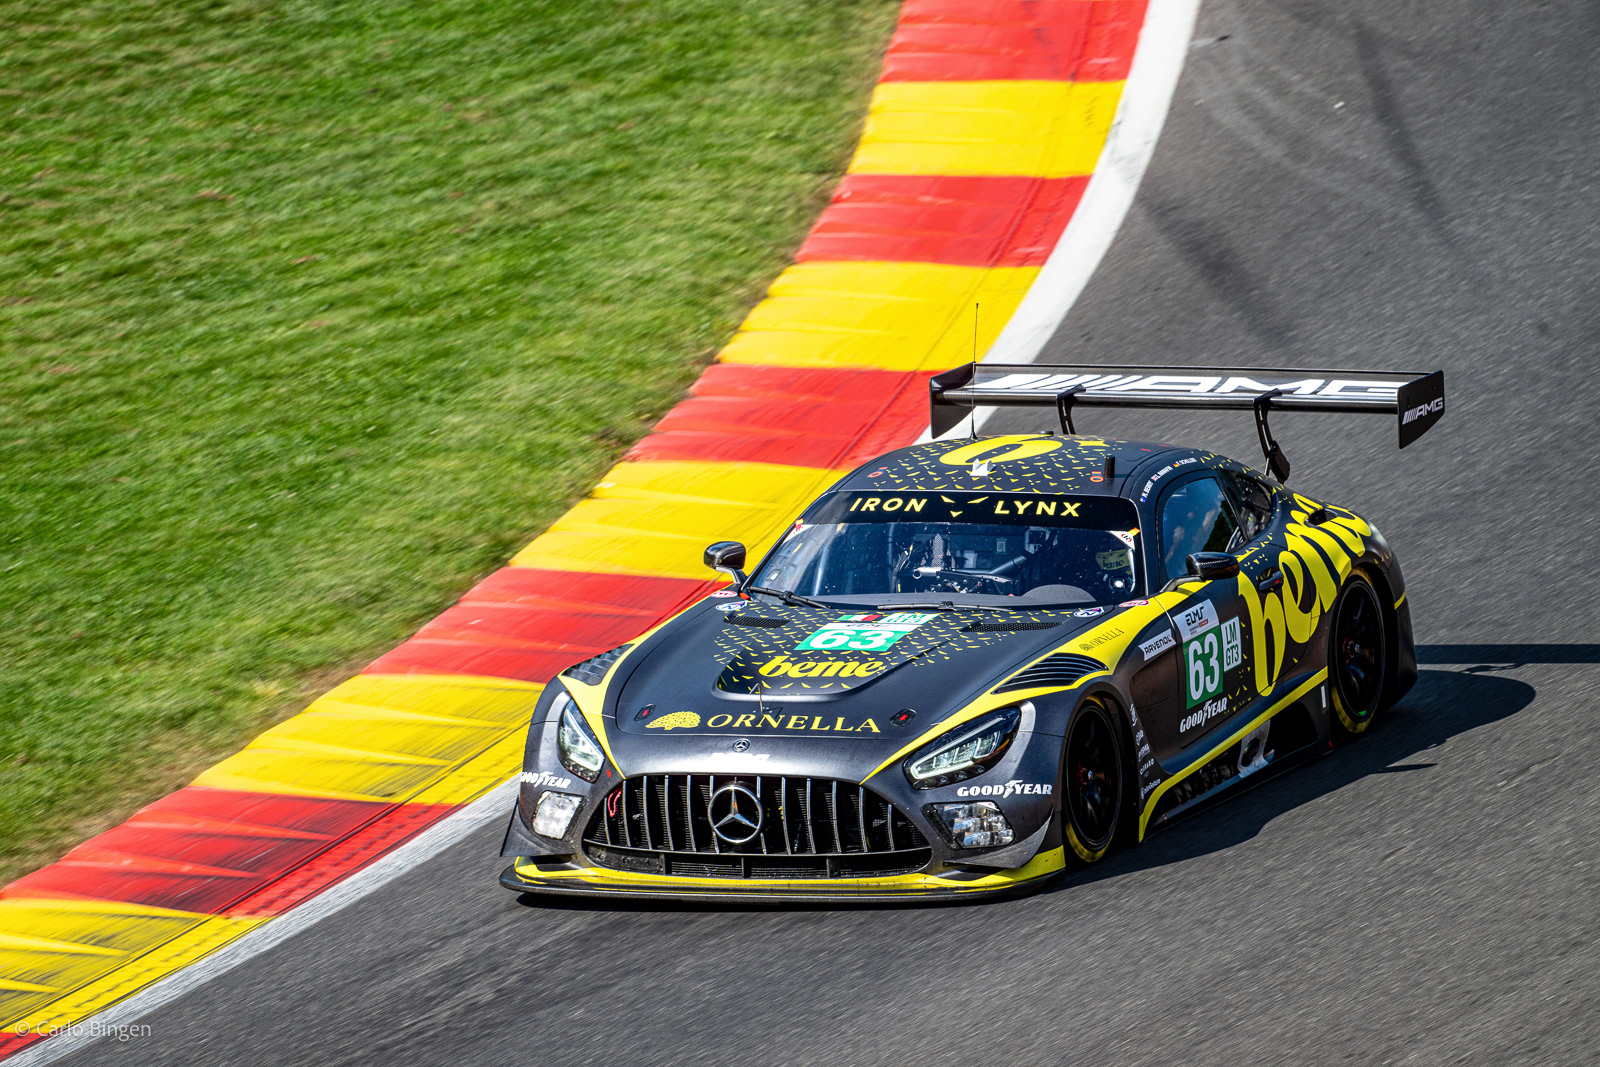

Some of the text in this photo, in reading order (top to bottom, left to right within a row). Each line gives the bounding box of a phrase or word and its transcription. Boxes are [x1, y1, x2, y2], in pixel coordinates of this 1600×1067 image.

[850, 498, 1081, 517] IRON LYNX
[809, 630, 895, 649] 63
[1089, 628, 1125, 647] ORNELLA
[1225, 622, 1238, 646] LM
[1144, 635, 1173, 655] RAVENOL
[1225, 644, 1239, 667] GT3
[758, 655, 885, 678] beme
[1188, 633, 1220, 701] 63
[707, 713, 881, 733] ORNELLA
[1180, 697, 1228, 733] GOODYEAR
[956, 780, 1053, 799] GOODYEAR
